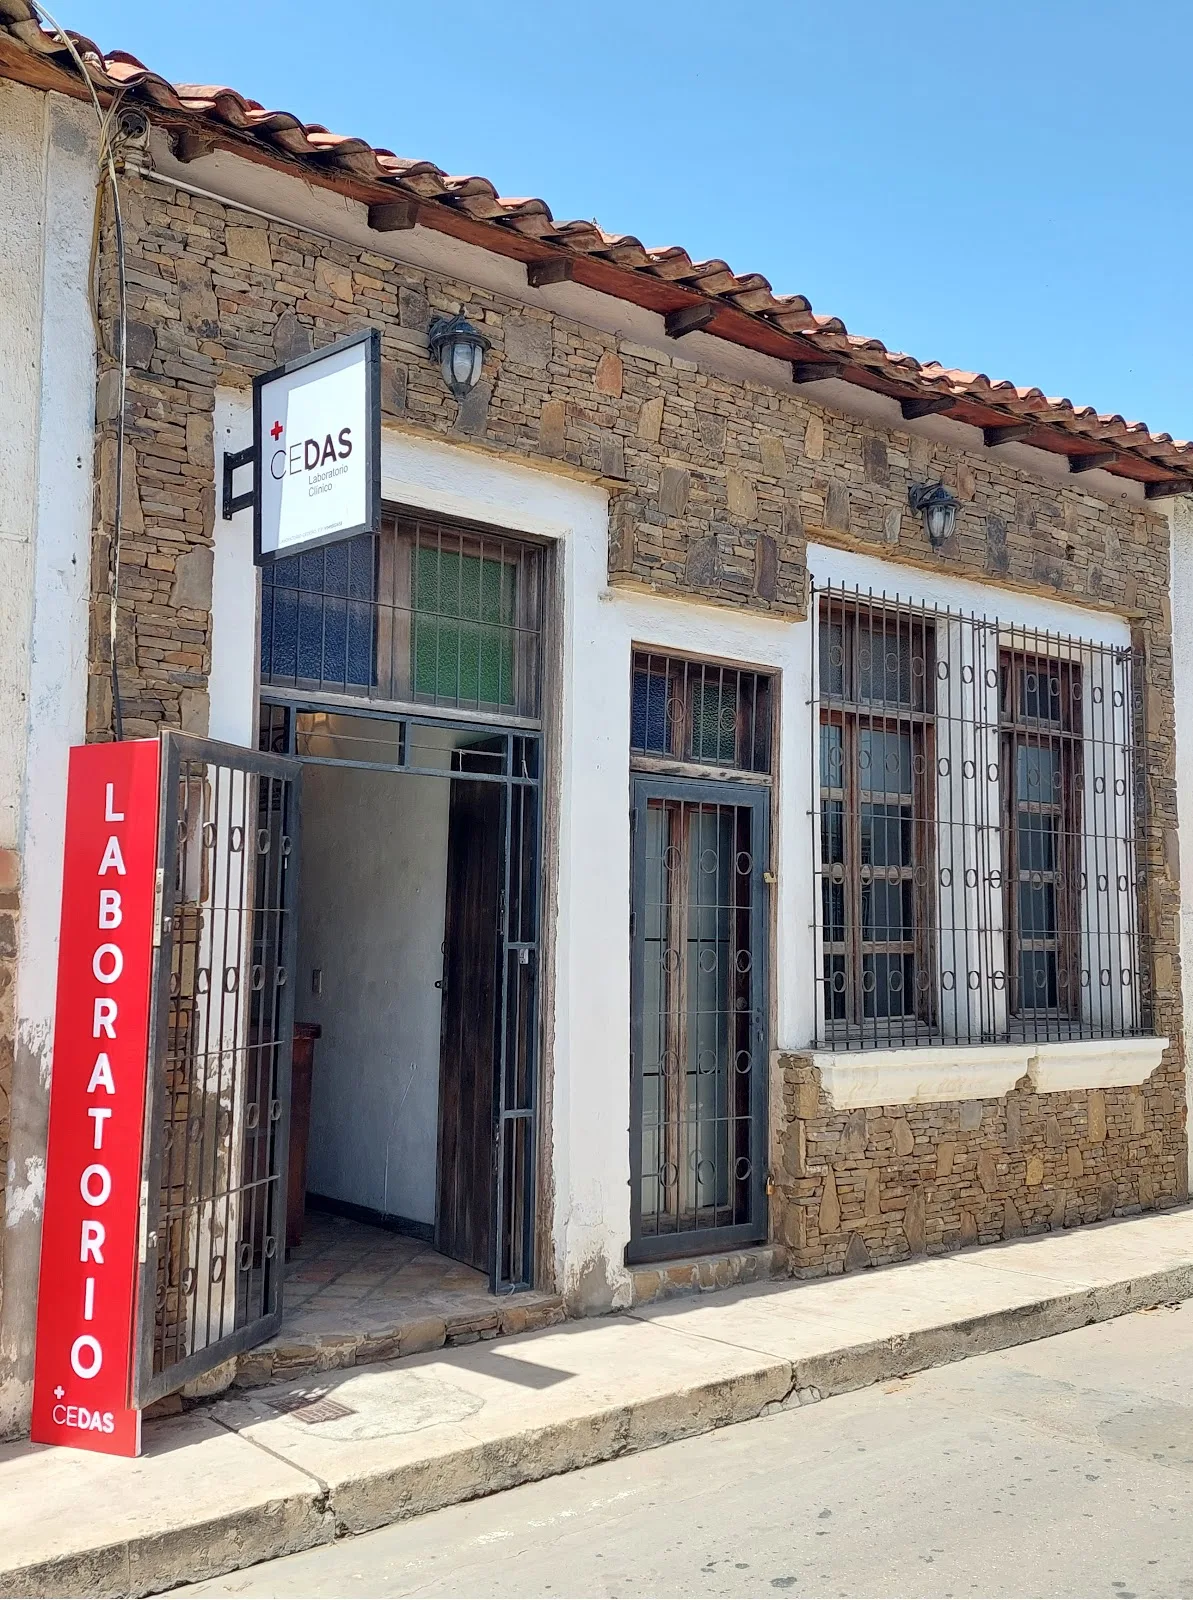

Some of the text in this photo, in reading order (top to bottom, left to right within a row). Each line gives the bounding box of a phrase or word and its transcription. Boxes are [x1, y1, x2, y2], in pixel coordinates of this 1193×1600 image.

[270, 427, 353, 480] CEDAS
[308, 464, 349, 485] Laboratorio
[70, 782, 127, 1379] LABORATORIO
[52, 1404, 115, 1434] CEDAS
